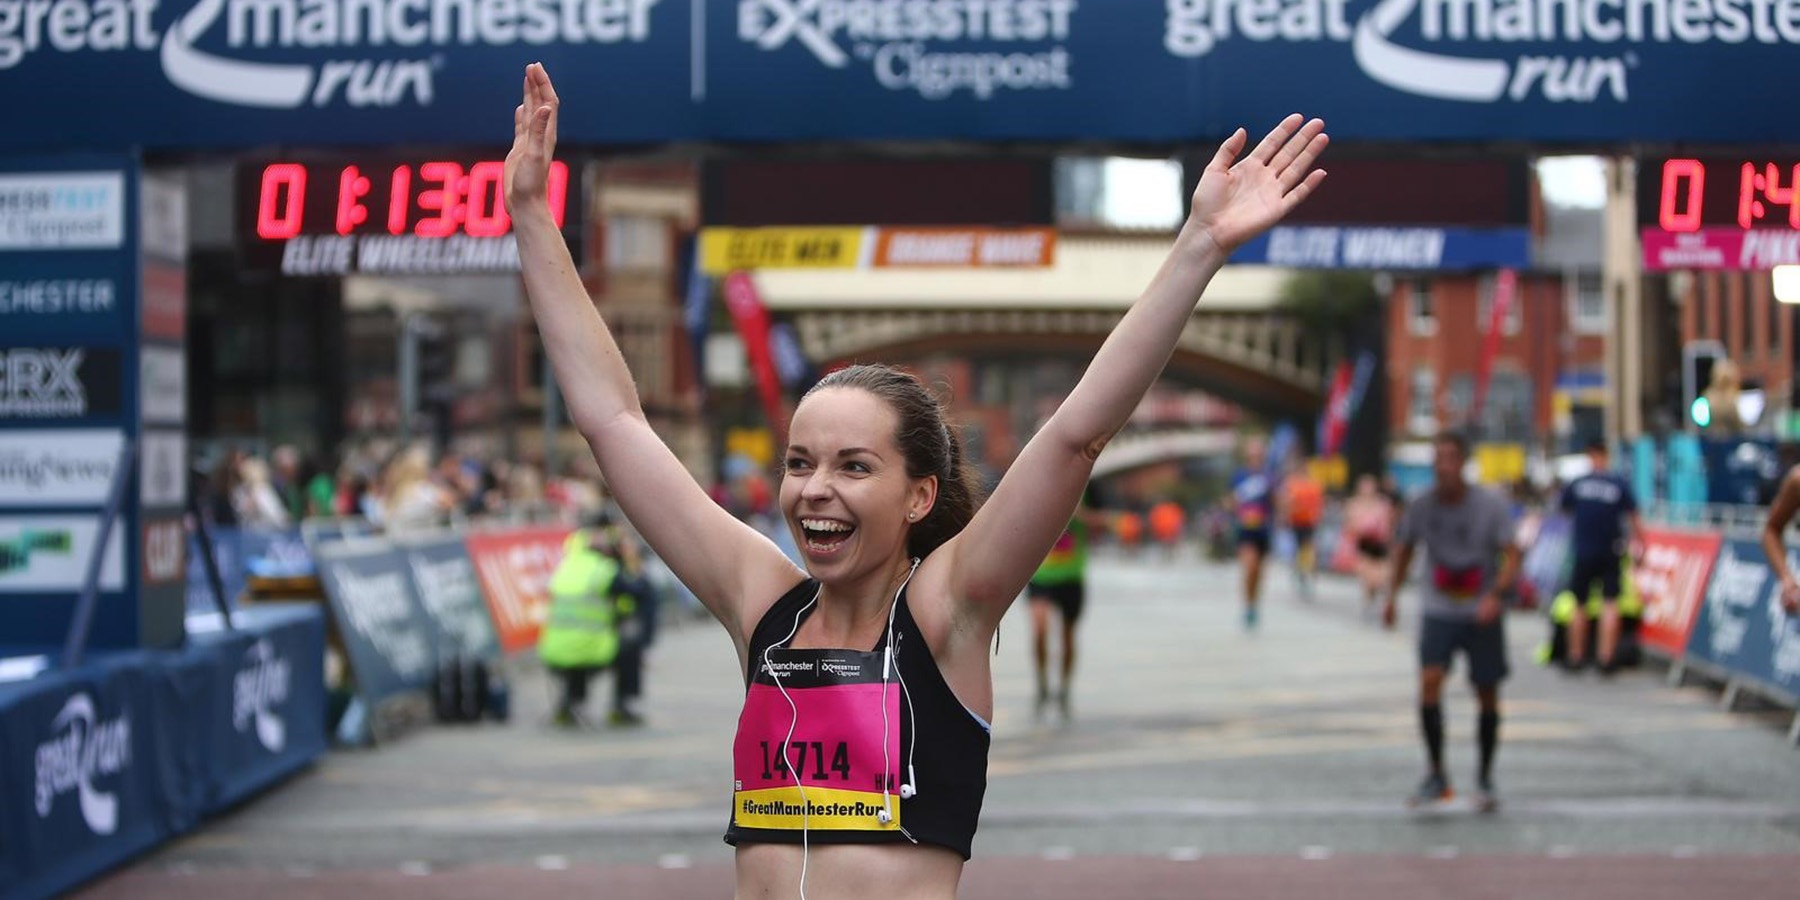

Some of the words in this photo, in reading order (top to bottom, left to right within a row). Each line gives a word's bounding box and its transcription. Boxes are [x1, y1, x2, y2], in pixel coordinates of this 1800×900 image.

[226, 0, 658, 48] manchester
[1163, 0, 1352, 57] great
[309, 58, 437, 106] run
[873, 41, 1073, 99] Cignpost
[1508, 54, 1629, 102] run
[282, 235, 354, 275] ELITE
[1265, 227, 1339, 268] ELITE
[1342, 227, 1445, 269] WOMEN
[760, 741, 849, 780] 14714
